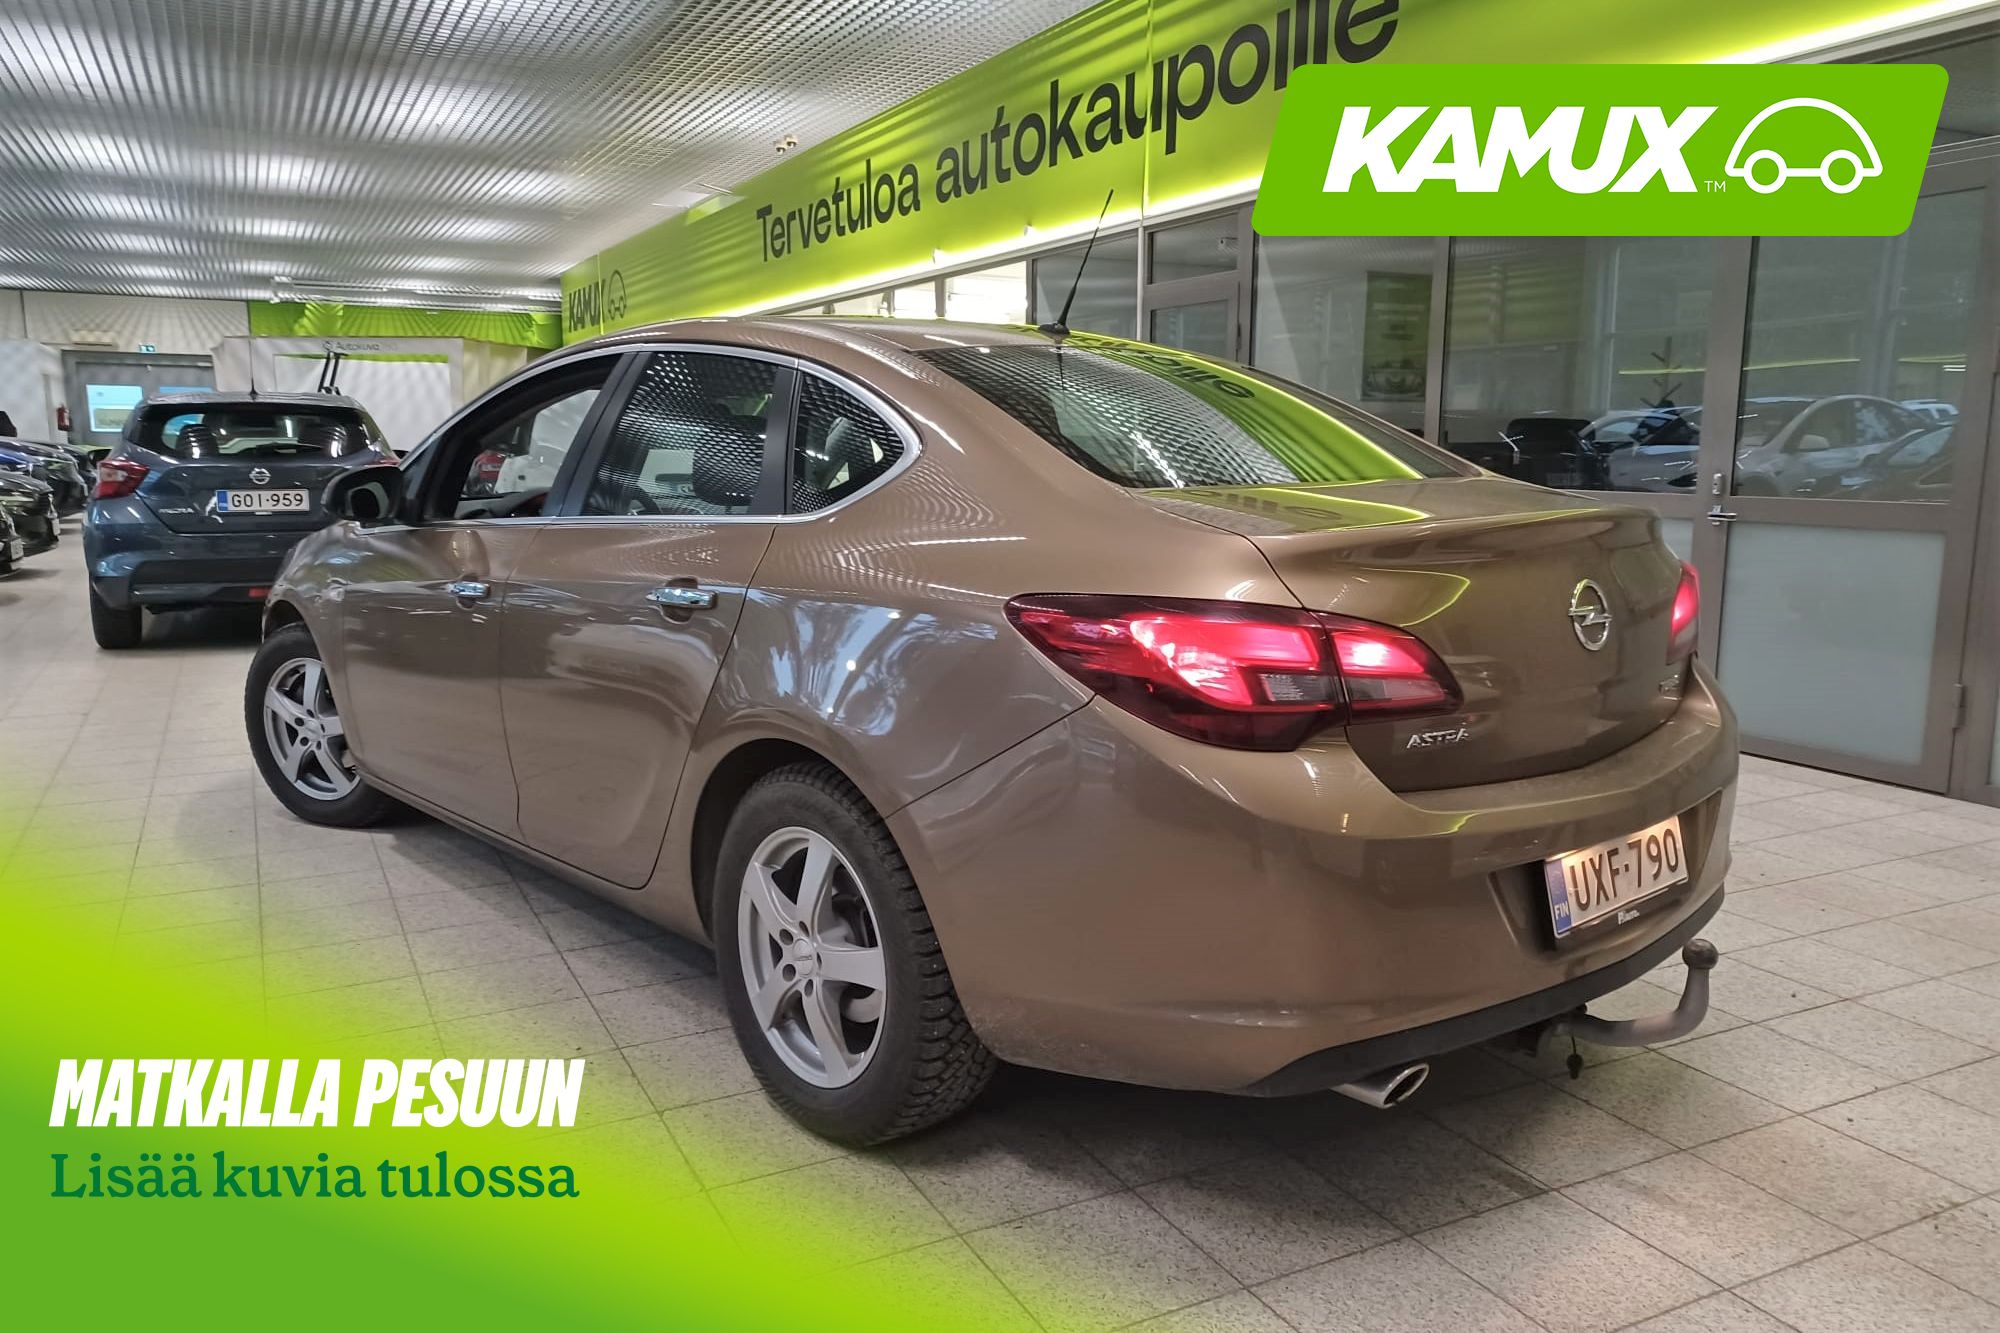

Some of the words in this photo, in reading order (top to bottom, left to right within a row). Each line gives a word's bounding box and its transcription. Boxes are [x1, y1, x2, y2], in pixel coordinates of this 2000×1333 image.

[756, 158, 920, 262] Tervetuloa
[936, 0, 1399, 203] autokaupoille
[231, 493, 304, 508] GOI-959
[1569, 828, 1679, 911] UXF-790
[1554, 901, 1570, 920] FIN
